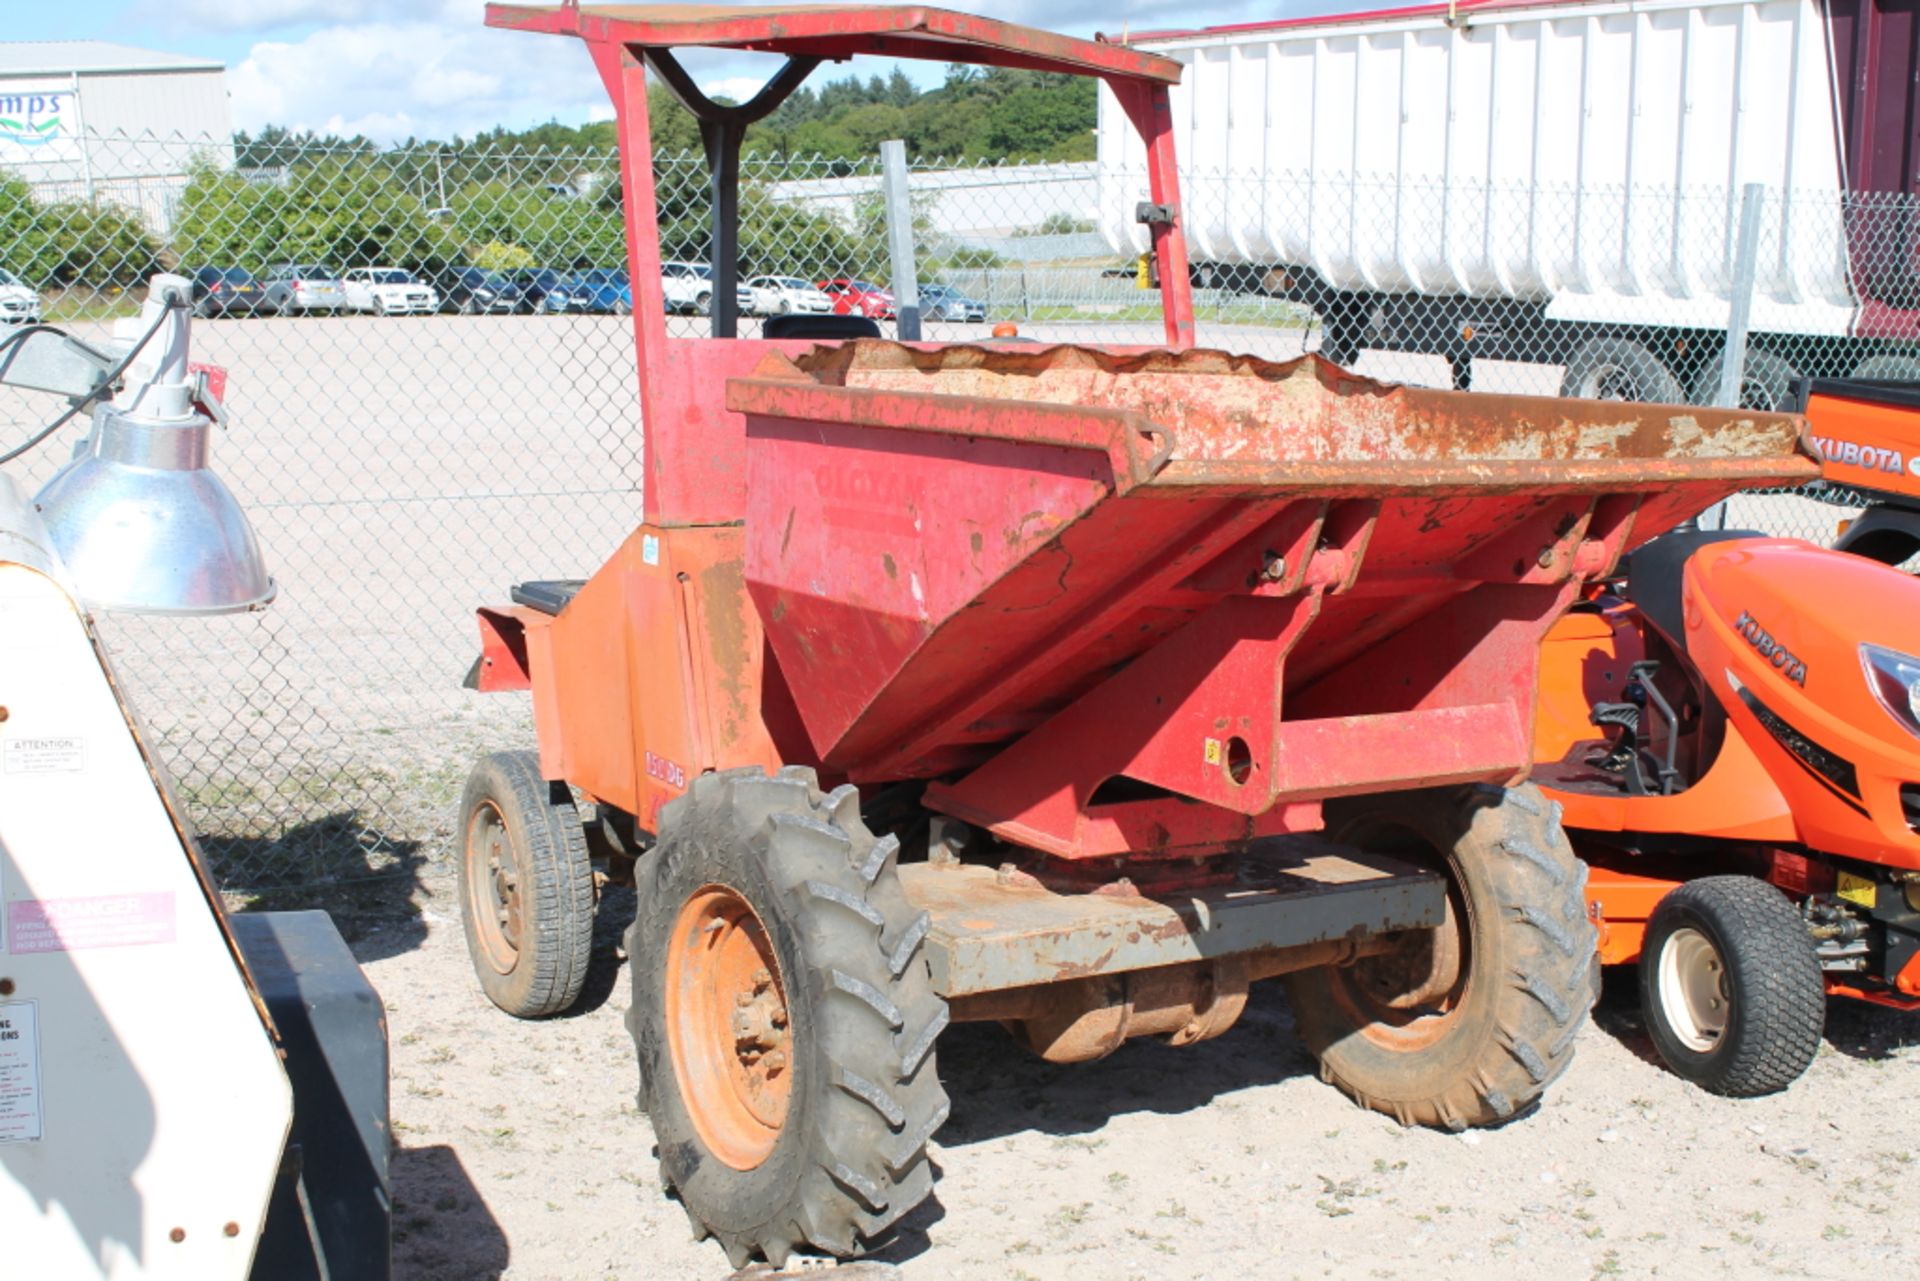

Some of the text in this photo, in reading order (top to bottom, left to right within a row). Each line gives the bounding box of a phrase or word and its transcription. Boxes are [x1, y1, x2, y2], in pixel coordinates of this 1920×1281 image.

[1808, 436, 1905, 475] KUBOTA
[1734, 609, 1808, 688] KUBOTA
[14, 739, 74, 749] ATTENTION
